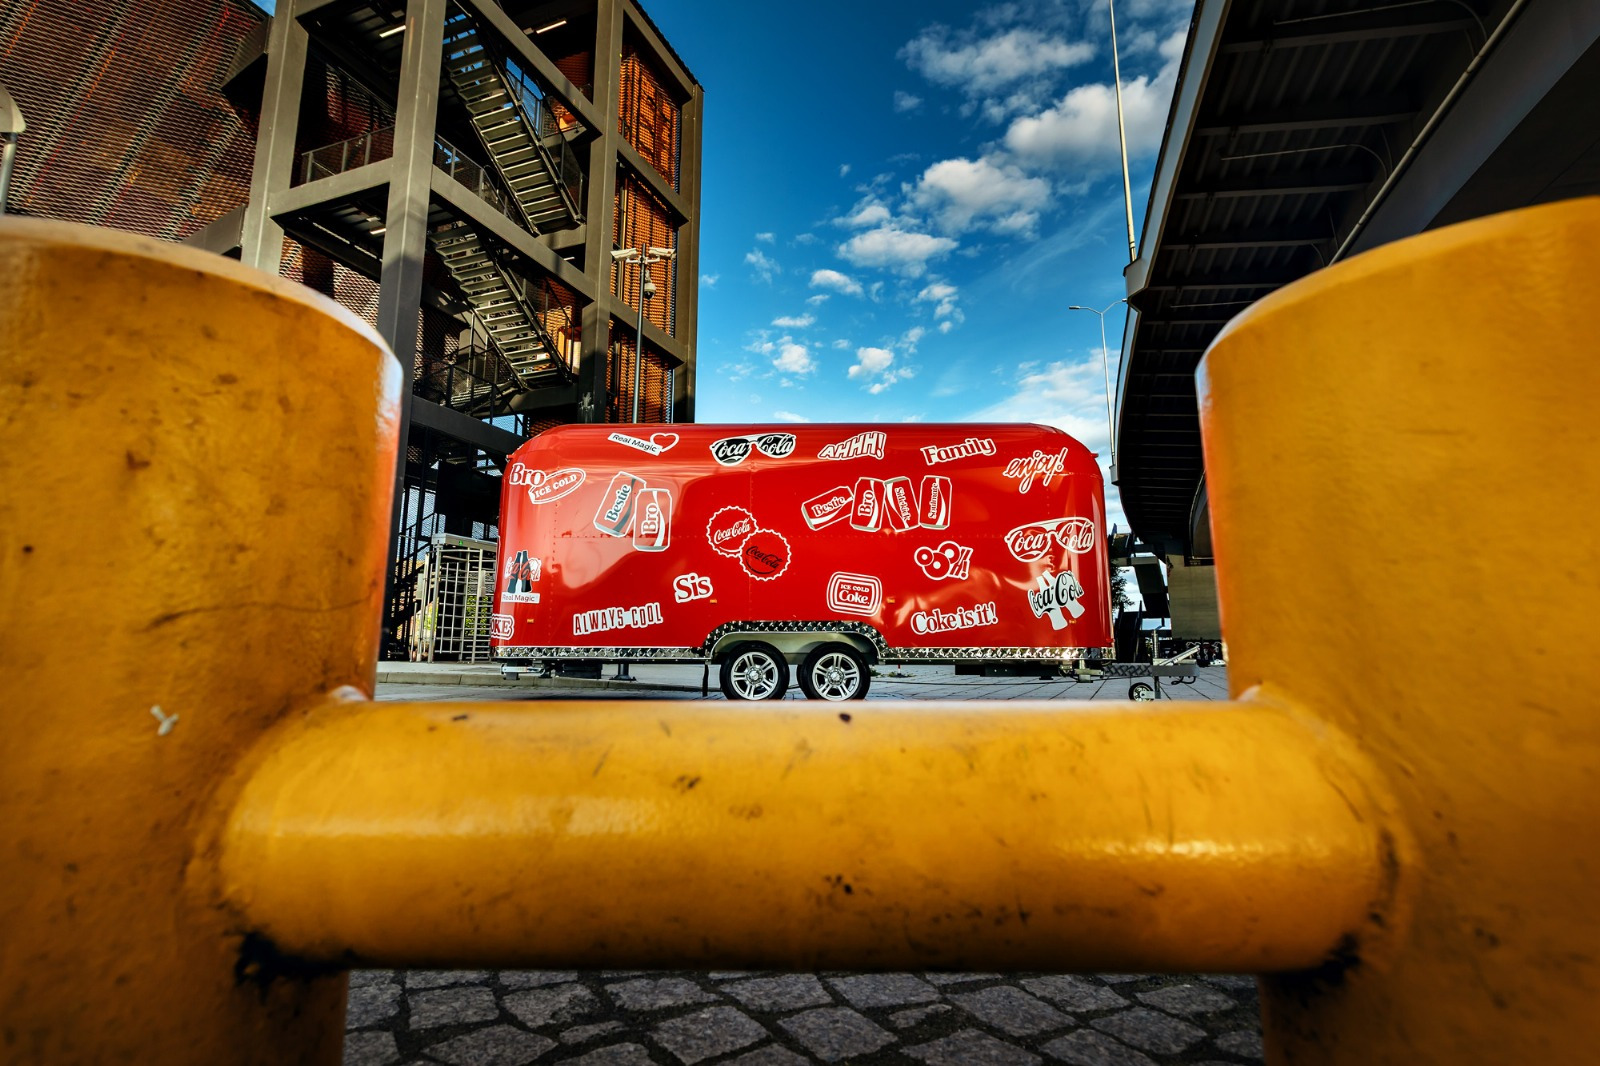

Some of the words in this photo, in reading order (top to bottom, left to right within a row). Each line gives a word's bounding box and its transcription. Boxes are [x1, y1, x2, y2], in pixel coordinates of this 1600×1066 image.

[612, 434, 631, 444] Real
[631, 439, 658, 452] Magic
[818, 432, 886, 460] AHHH!
[921, 438, 996, 465] Family
[510, 463, 546, 486] Bro
[1003, 447, 1068, 493] enjoy!
[535, 486, 552, 498] ICE
[552, 474, 577, 490] COLD
[604, 484, 631, 522] Bestie
[811, 496, 846, 517] Bestie
[858, 490, 875, 517] Bro
[641, 503, 659, 535] Bro
[502, 594, 514, 602] Real
[673, 573, 713, 603] Sis
[852, 585, 870, 593] COLD
[574, 608, 625, 635] ALWAYS
[630, 603, 663, 628] COOL
[911, 609, 957, 635] Coke
[957, 606, 974, 629] is
[975, 602, 998, 626] it!
